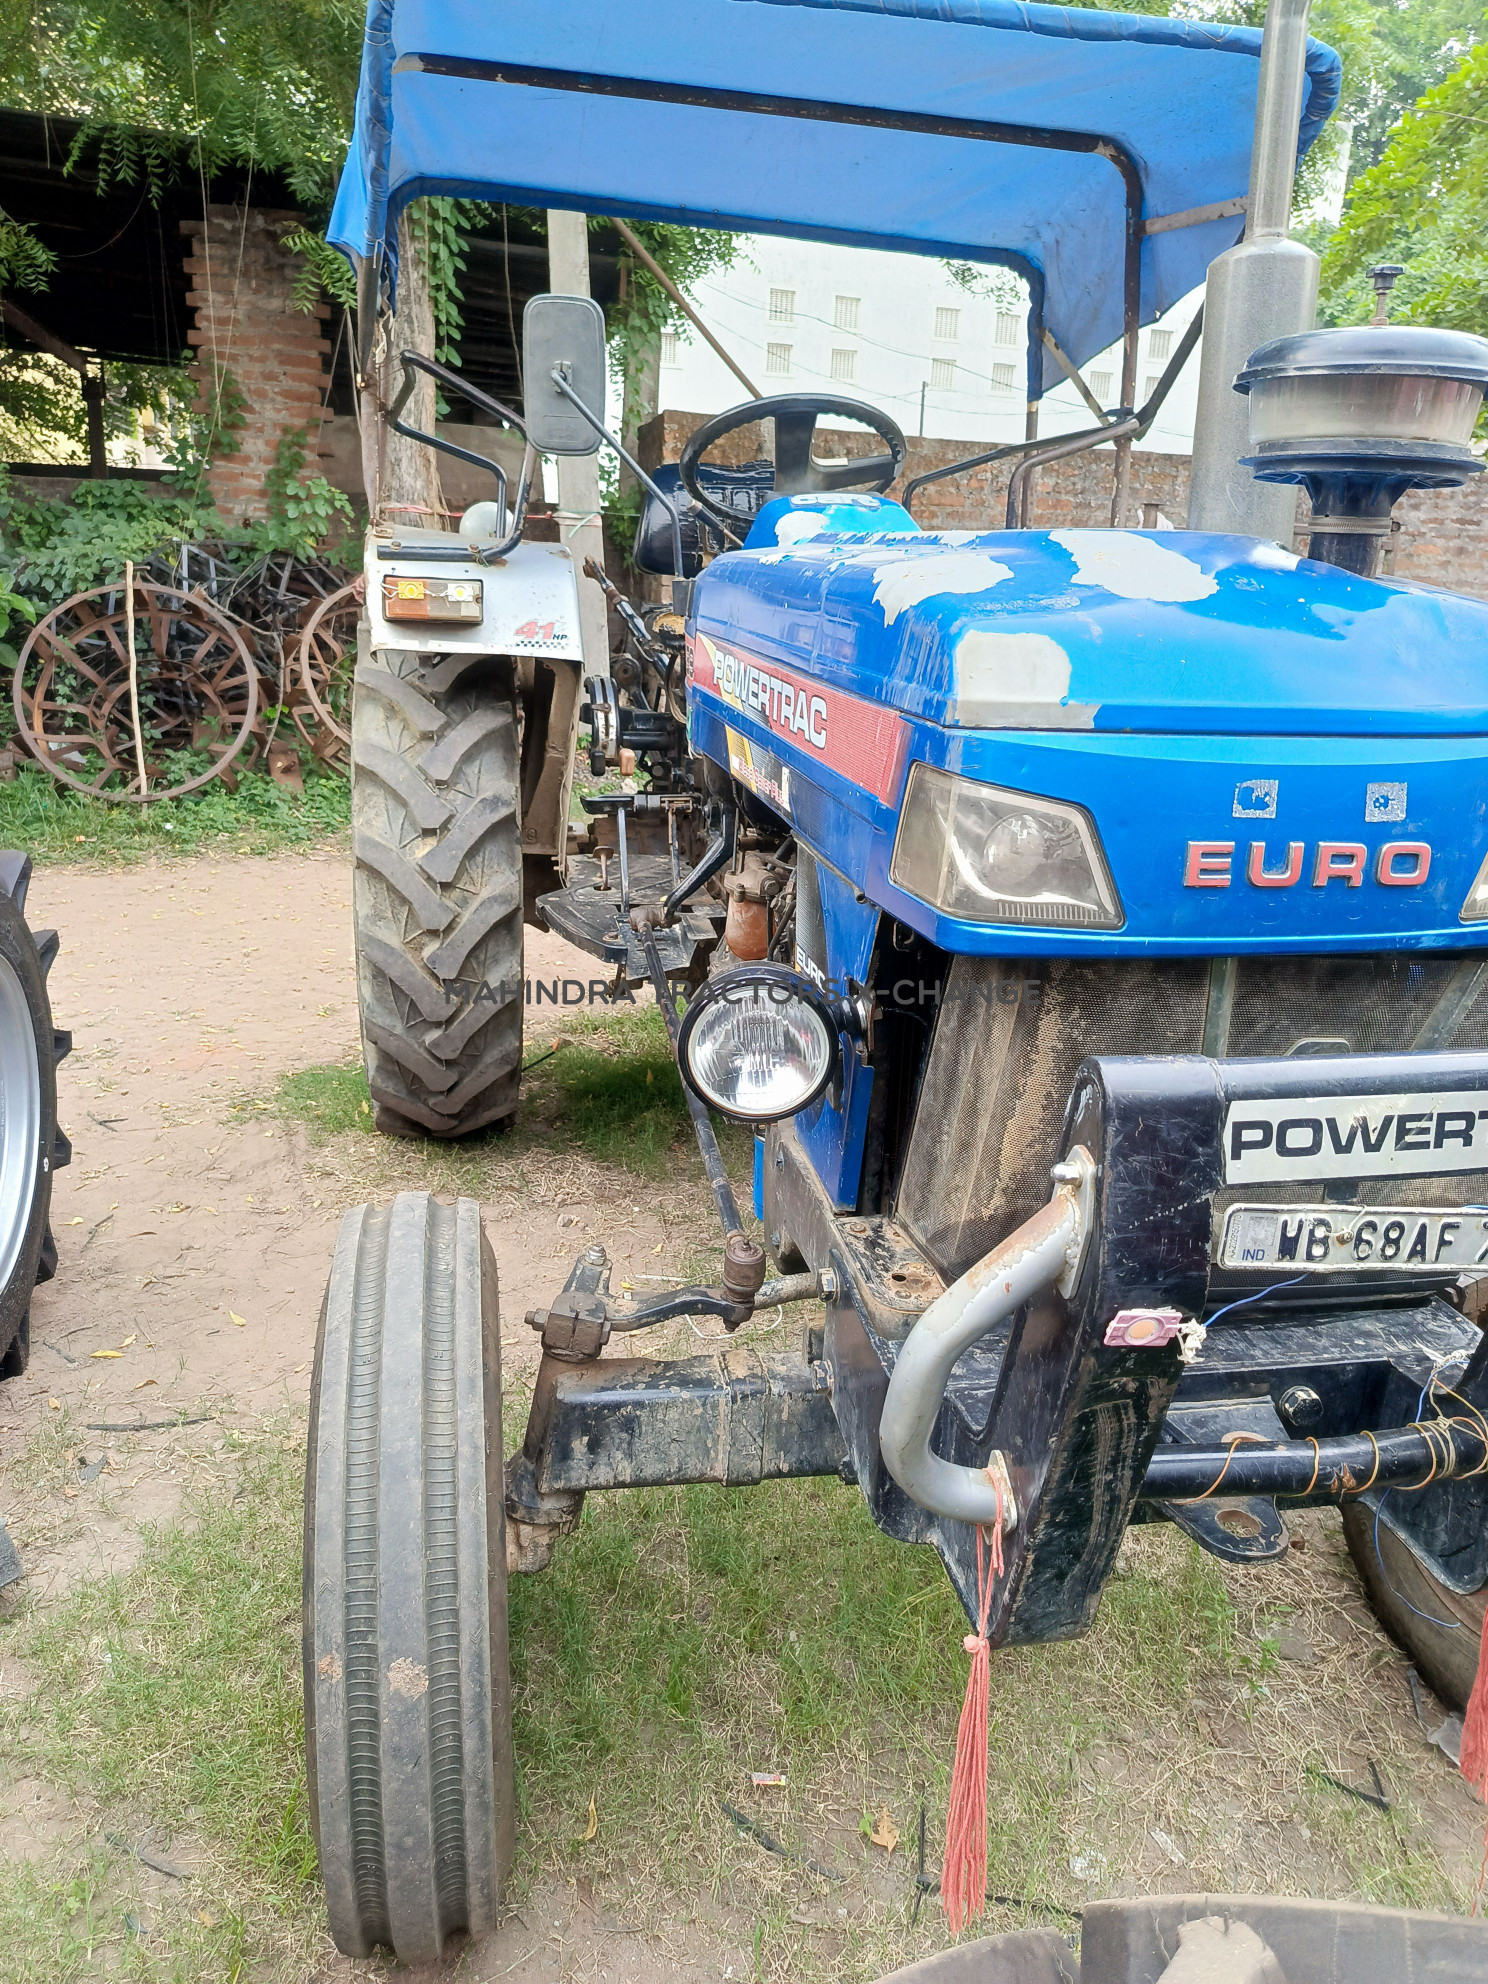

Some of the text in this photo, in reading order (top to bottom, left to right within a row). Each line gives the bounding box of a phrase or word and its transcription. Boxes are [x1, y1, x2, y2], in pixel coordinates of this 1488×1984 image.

[514, 619, 556, 640] 41
[713, 649, 828, 749] POWERTRAC
[1183, 840, 1433, 888] EURO
[1242, 1249, 1265, 1261] IND
